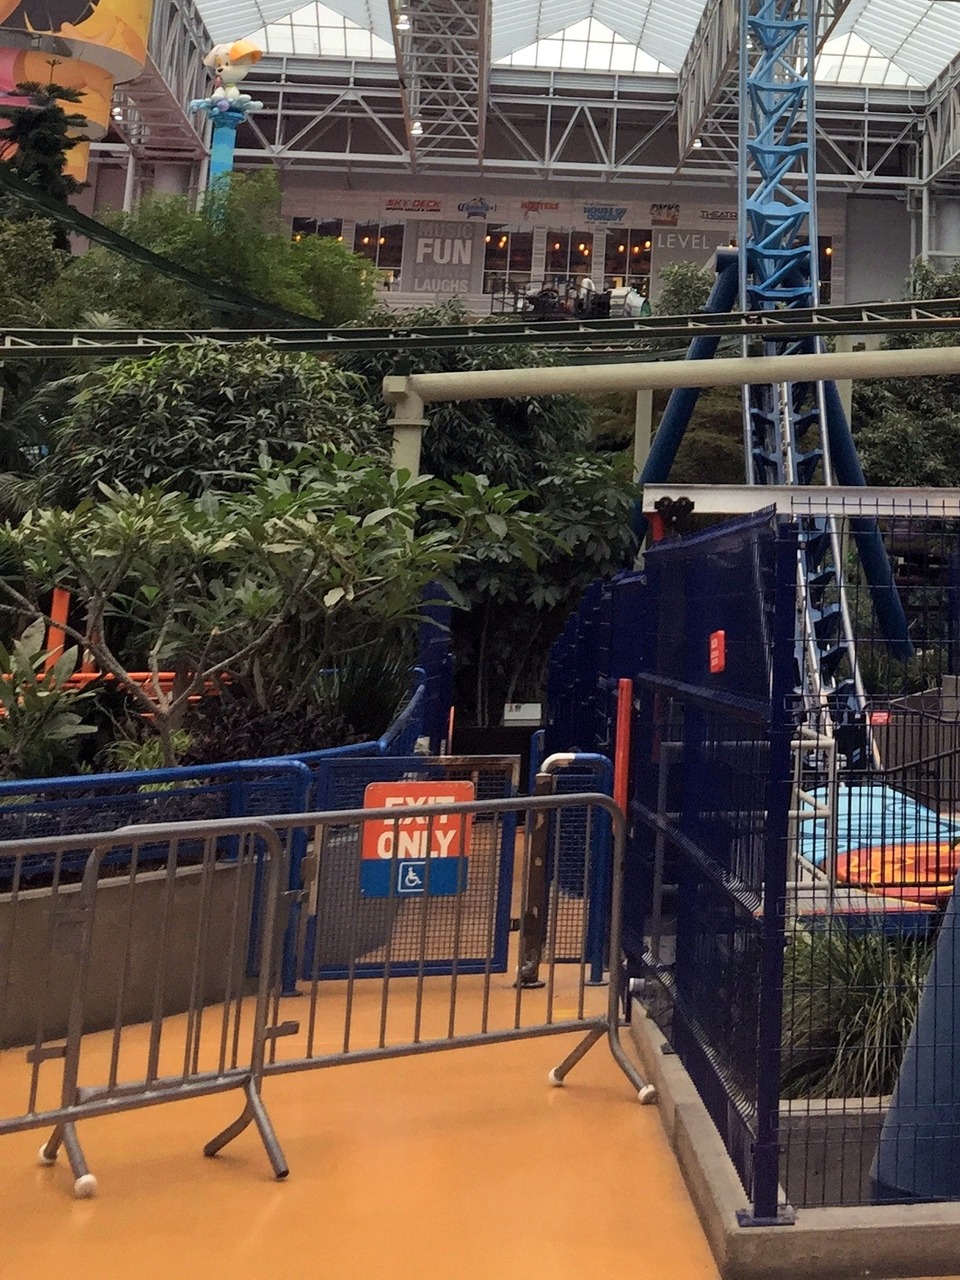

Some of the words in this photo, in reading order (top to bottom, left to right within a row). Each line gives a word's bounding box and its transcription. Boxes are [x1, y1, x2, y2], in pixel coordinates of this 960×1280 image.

[386, 199, 410, 208] SKY
[412, 200, 441, 209] DECK
[418, 222, 474, 238] MUSIC
[657, 233, 710, 250] LEVEL
[416, 237, 473, 265] FUN
[413, 278, 469, 293] LAUGHS
[376, 829, 457, 859] ONLY
